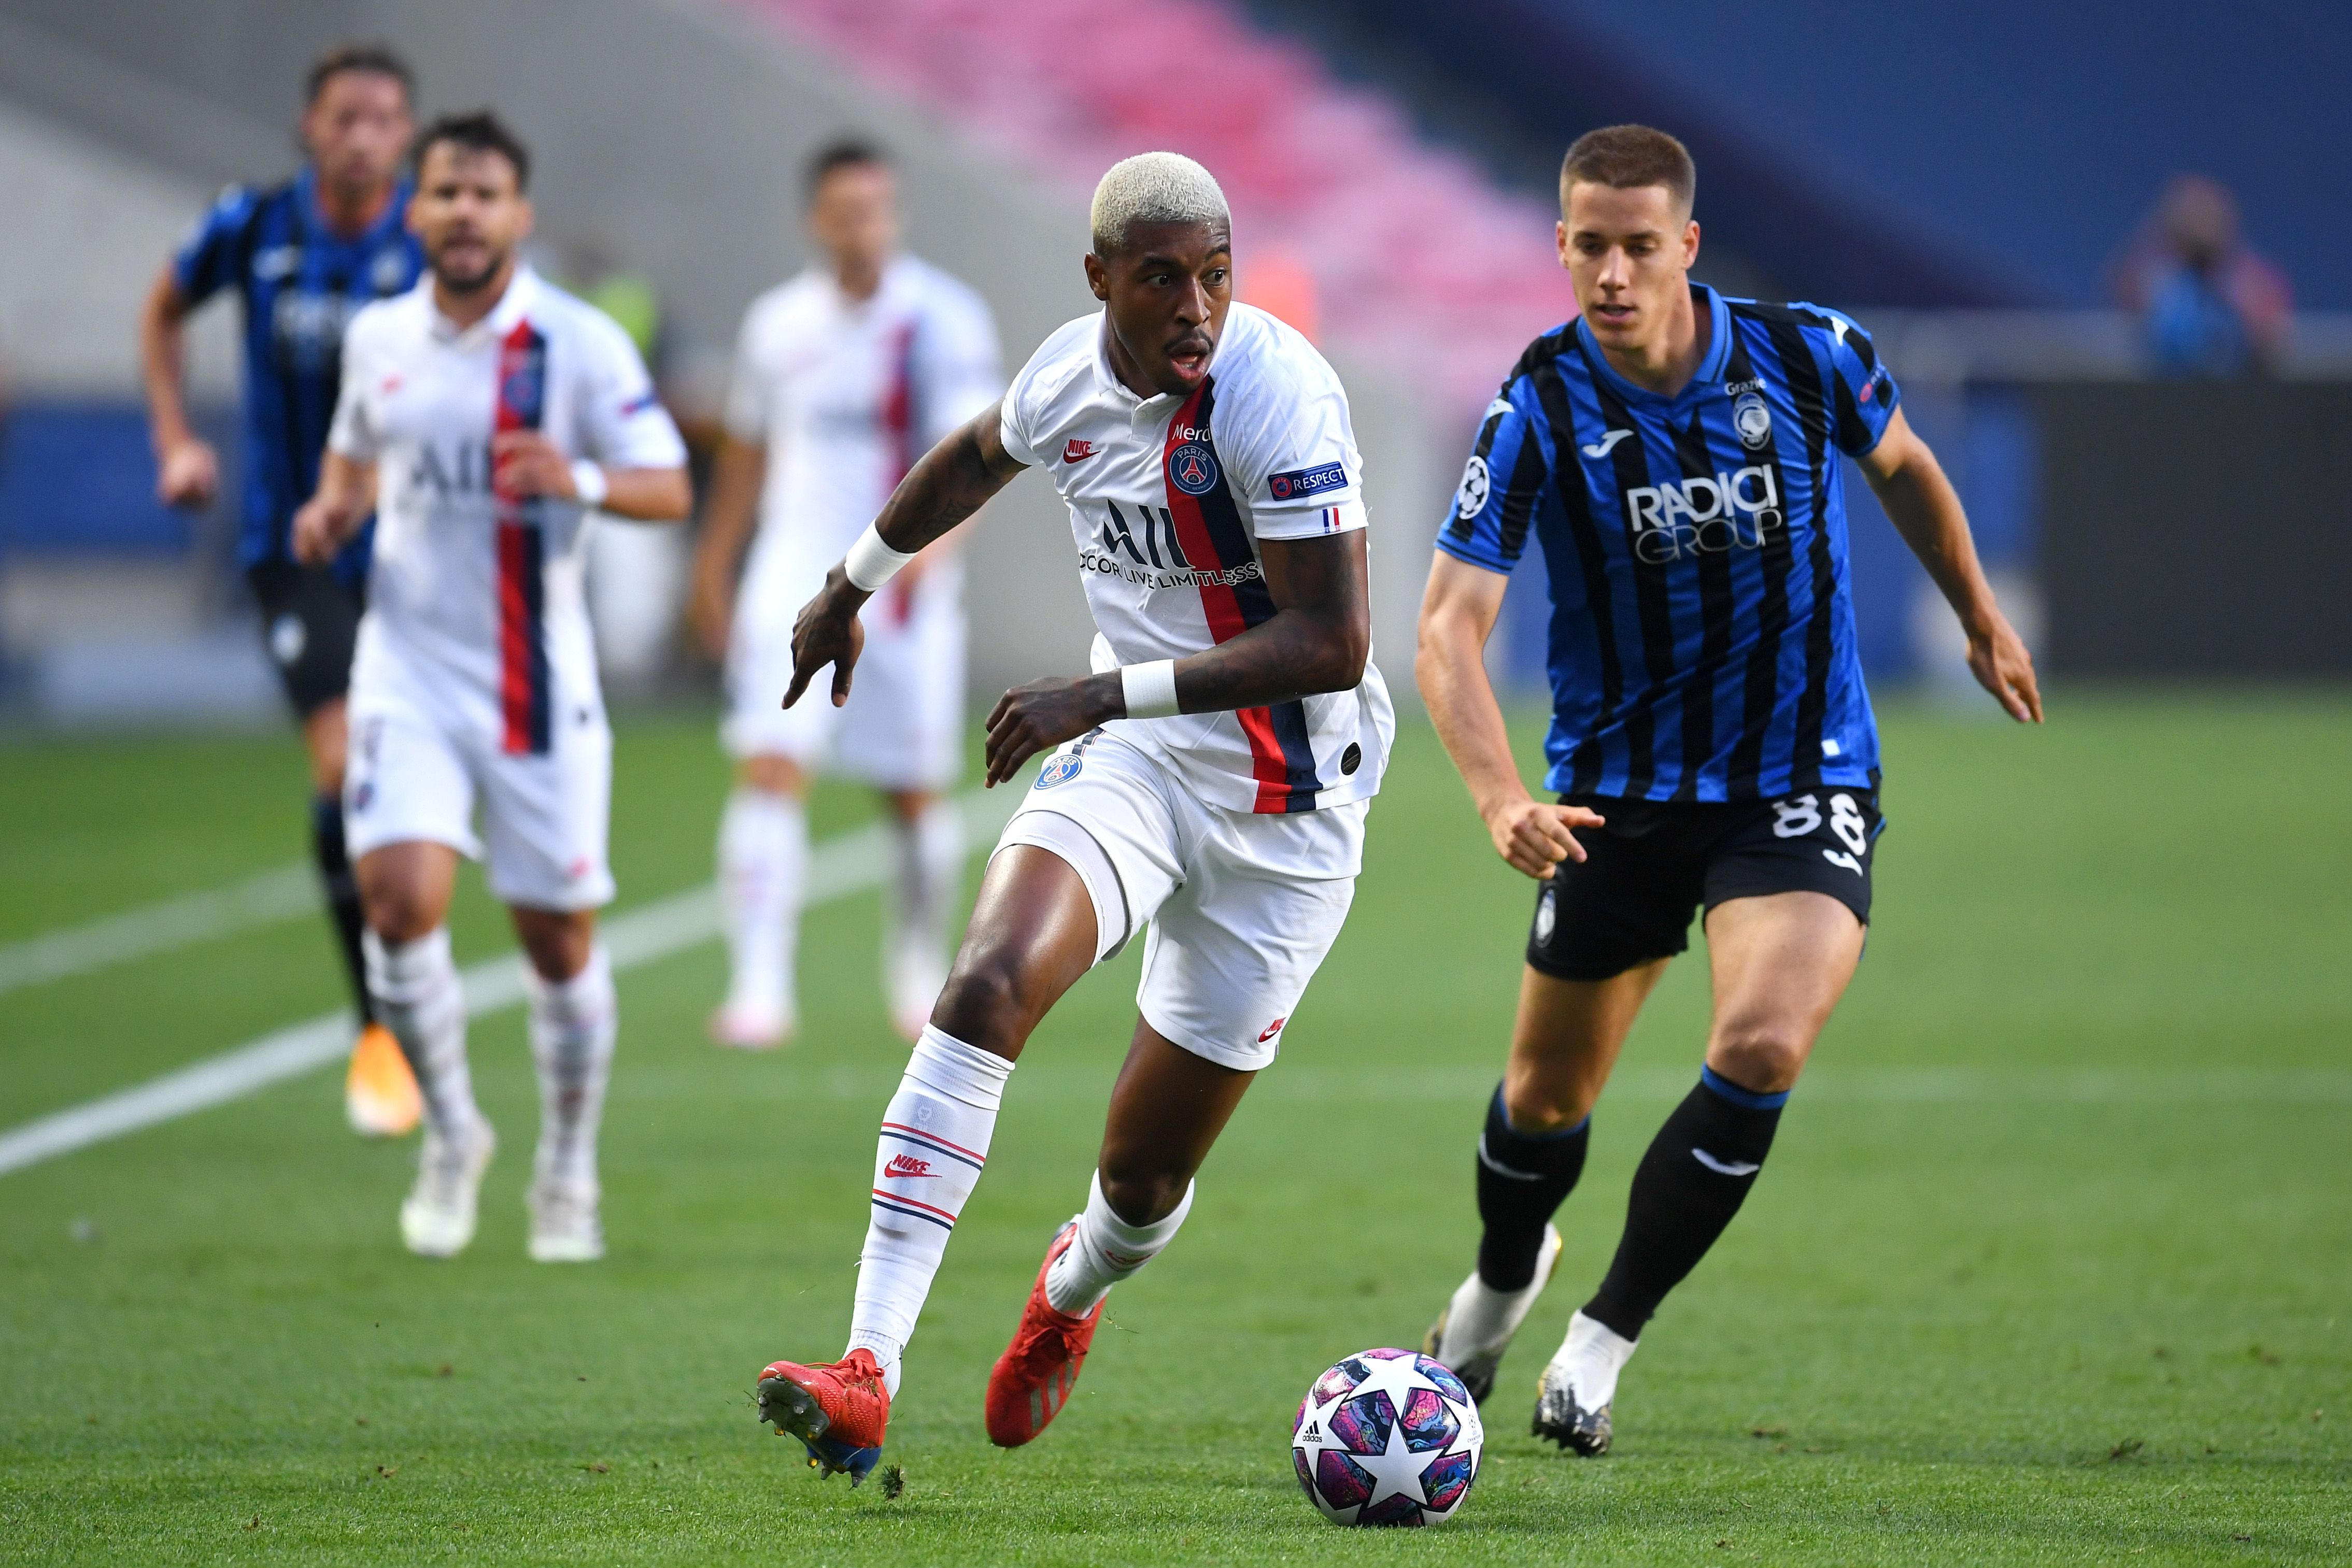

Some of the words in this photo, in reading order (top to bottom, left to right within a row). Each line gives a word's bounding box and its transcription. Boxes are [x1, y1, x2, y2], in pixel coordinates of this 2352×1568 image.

[1172, 423, 1211, 441] Merci
[1068, 439, 1092, 455] NIKE
[1177, 448, 1208, 461] PARIS
[1293, 468, 1342, 491] RESPECT
[1626, 464, 1779, 532] RADICI
[1636, 508, 1782, 564] GROUP
[1080, 552, 1123, 578] CCOR
[1124, 566, 1155, 590] LIVE
[1157, 562, 1260, 589] LIMITLESS
[1771, 793, 1867, 856] 88
[892, 1153, 931, 1174] NIKE
[1302, 1434, 1323, 1443] adidas
